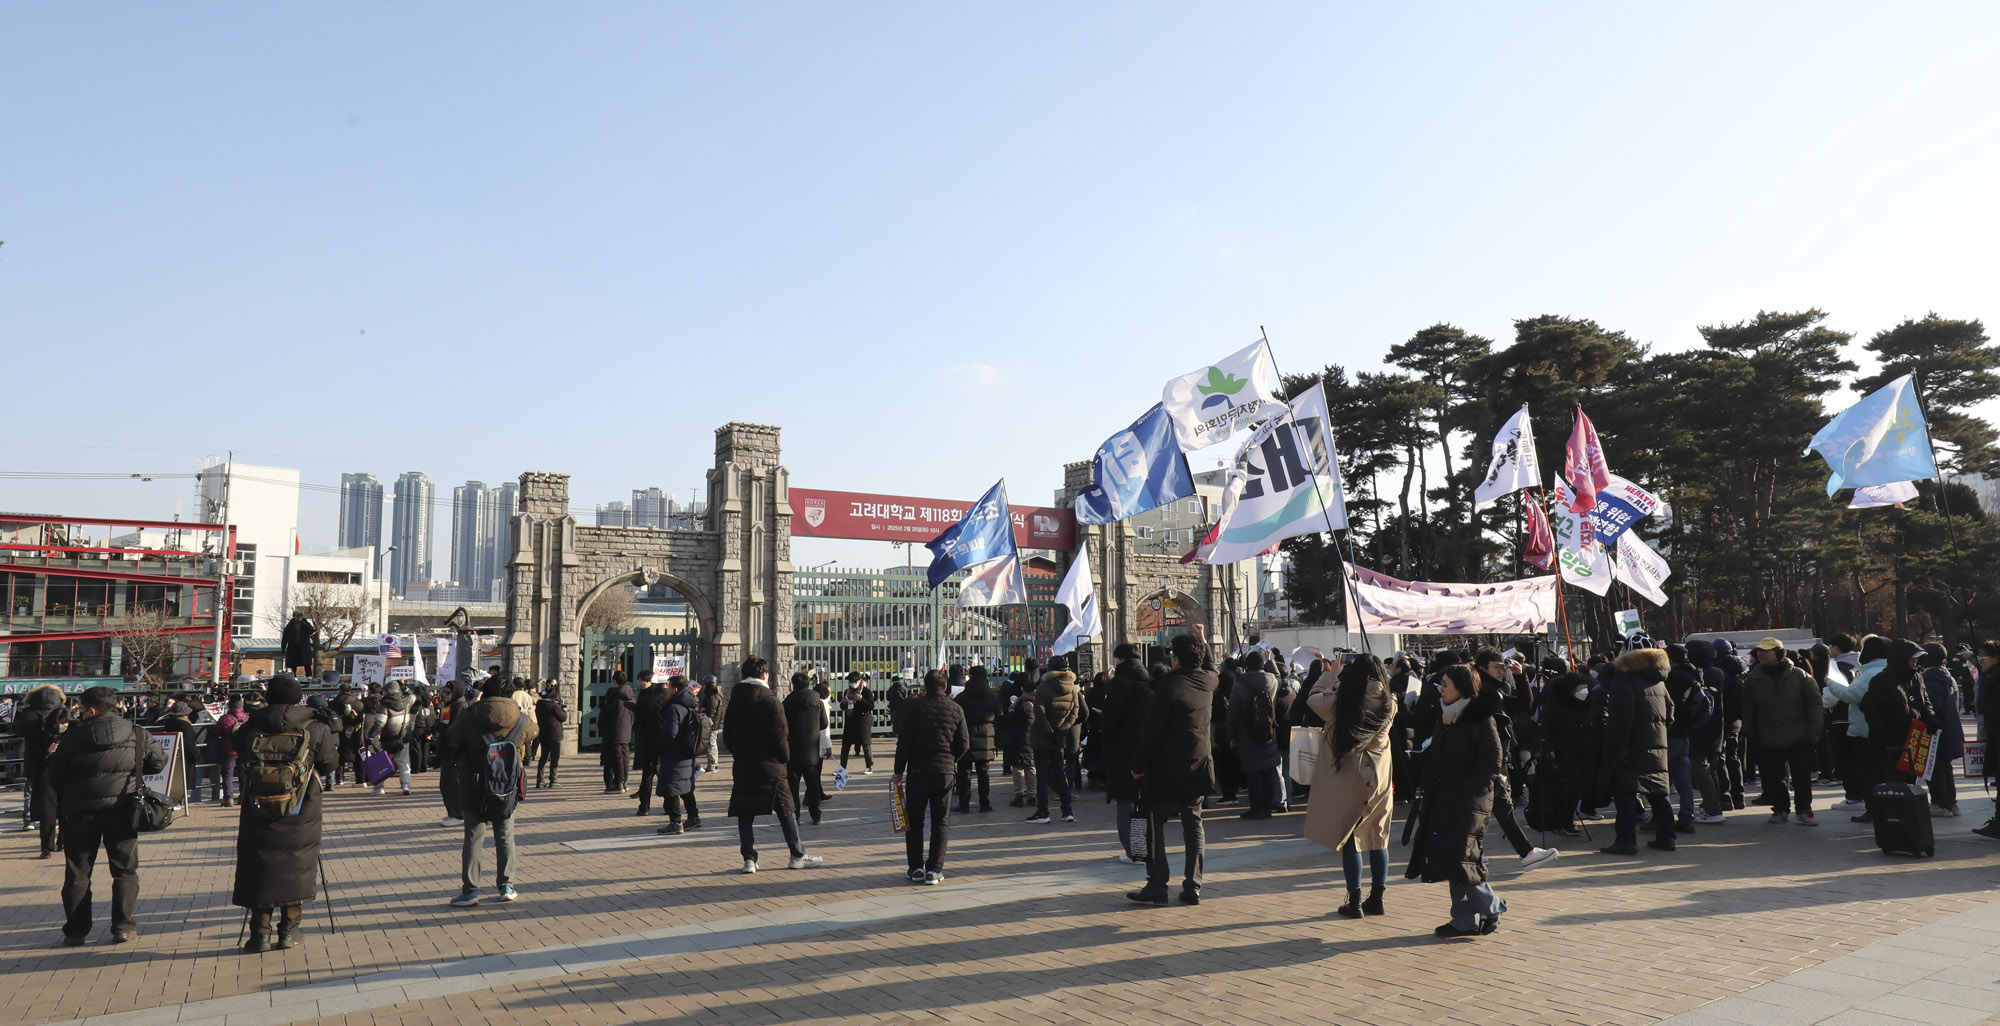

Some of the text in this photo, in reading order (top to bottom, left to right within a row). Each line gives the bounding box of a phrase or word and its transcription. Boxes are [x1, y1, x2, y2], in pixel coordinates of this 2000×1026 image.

[1624, 485, 1656, 507] HEALTH
[849, 501, 916, 521] 고려대학교
[920, 507, 962, 522] 제118회
[1634, 499, 1649, 513] ALL
[1606, 507, 1632, 525] 위한
[5, 683, 85, 694] NAEA
[1965, 745, 1985, 755] 계엄옹
[1914, 747, 1928, 772] 윤석열
